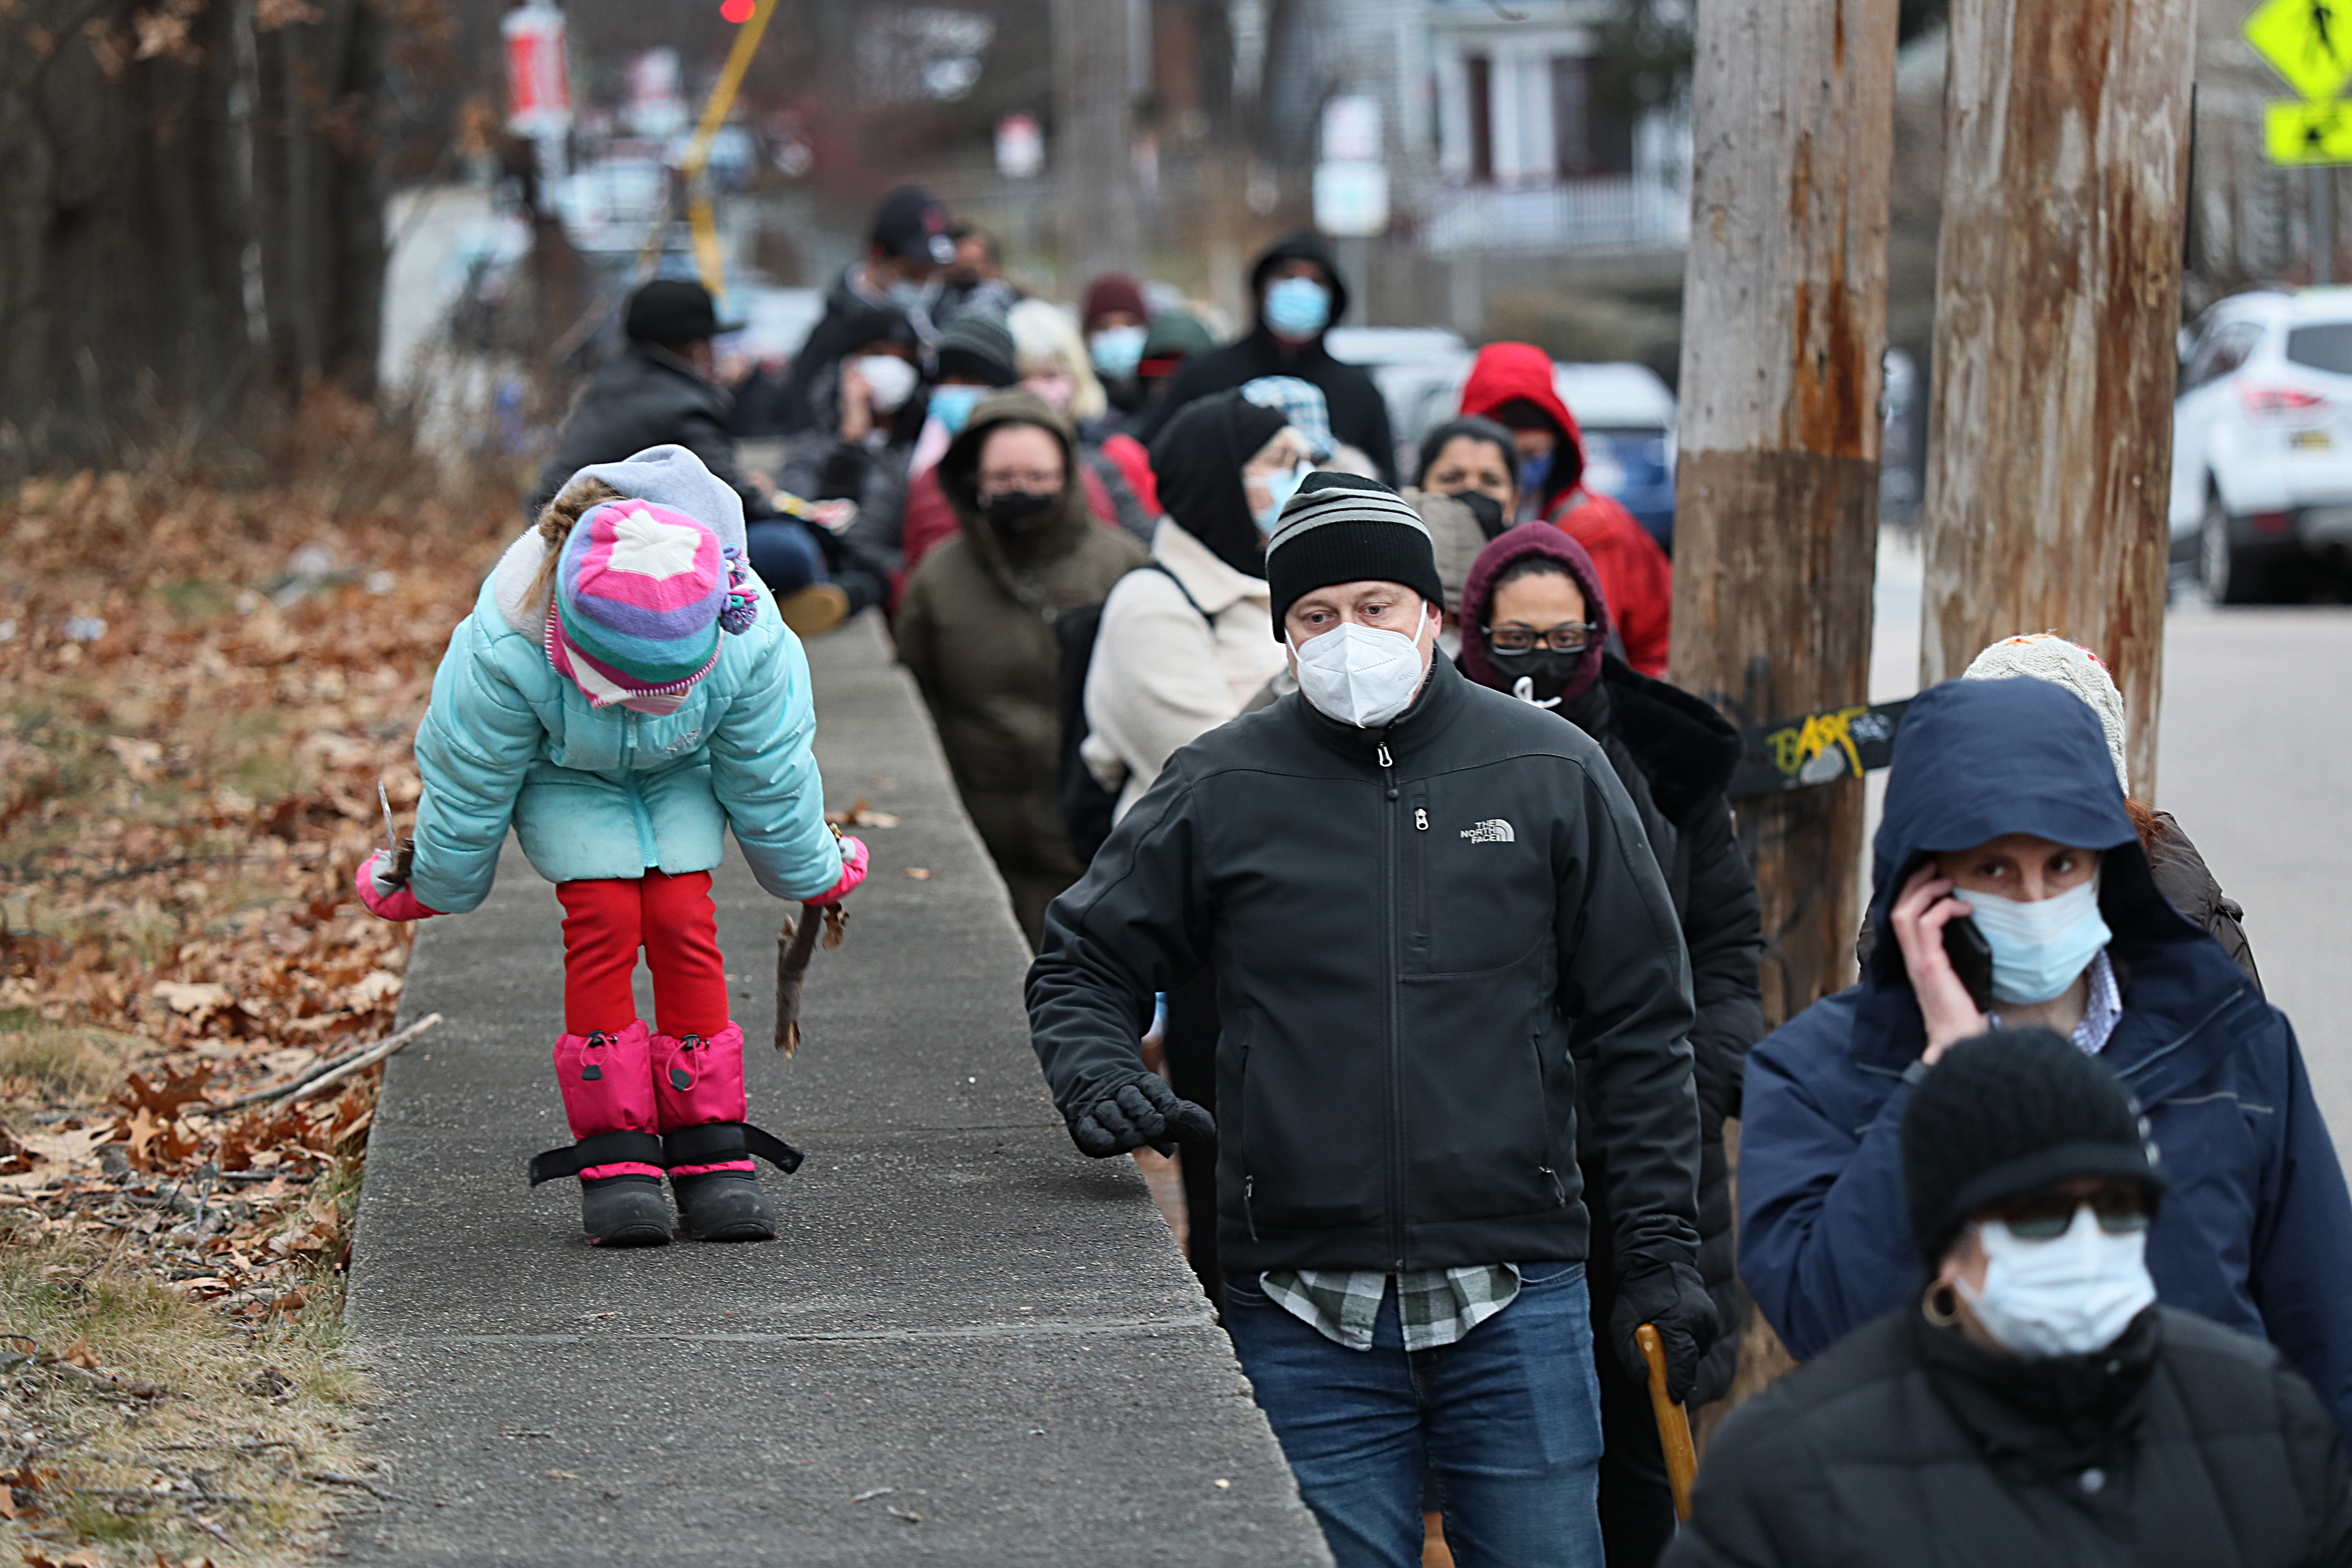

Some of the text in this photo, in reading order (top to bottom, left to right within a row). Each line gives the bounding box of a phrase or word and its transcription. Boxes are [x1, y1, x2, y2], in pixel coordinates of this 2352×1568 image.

[1474, 819, 1496, 828] THE
[1460, 827, 1495, 838] NORTH
[1471, 834, 1497, 844] FACE
